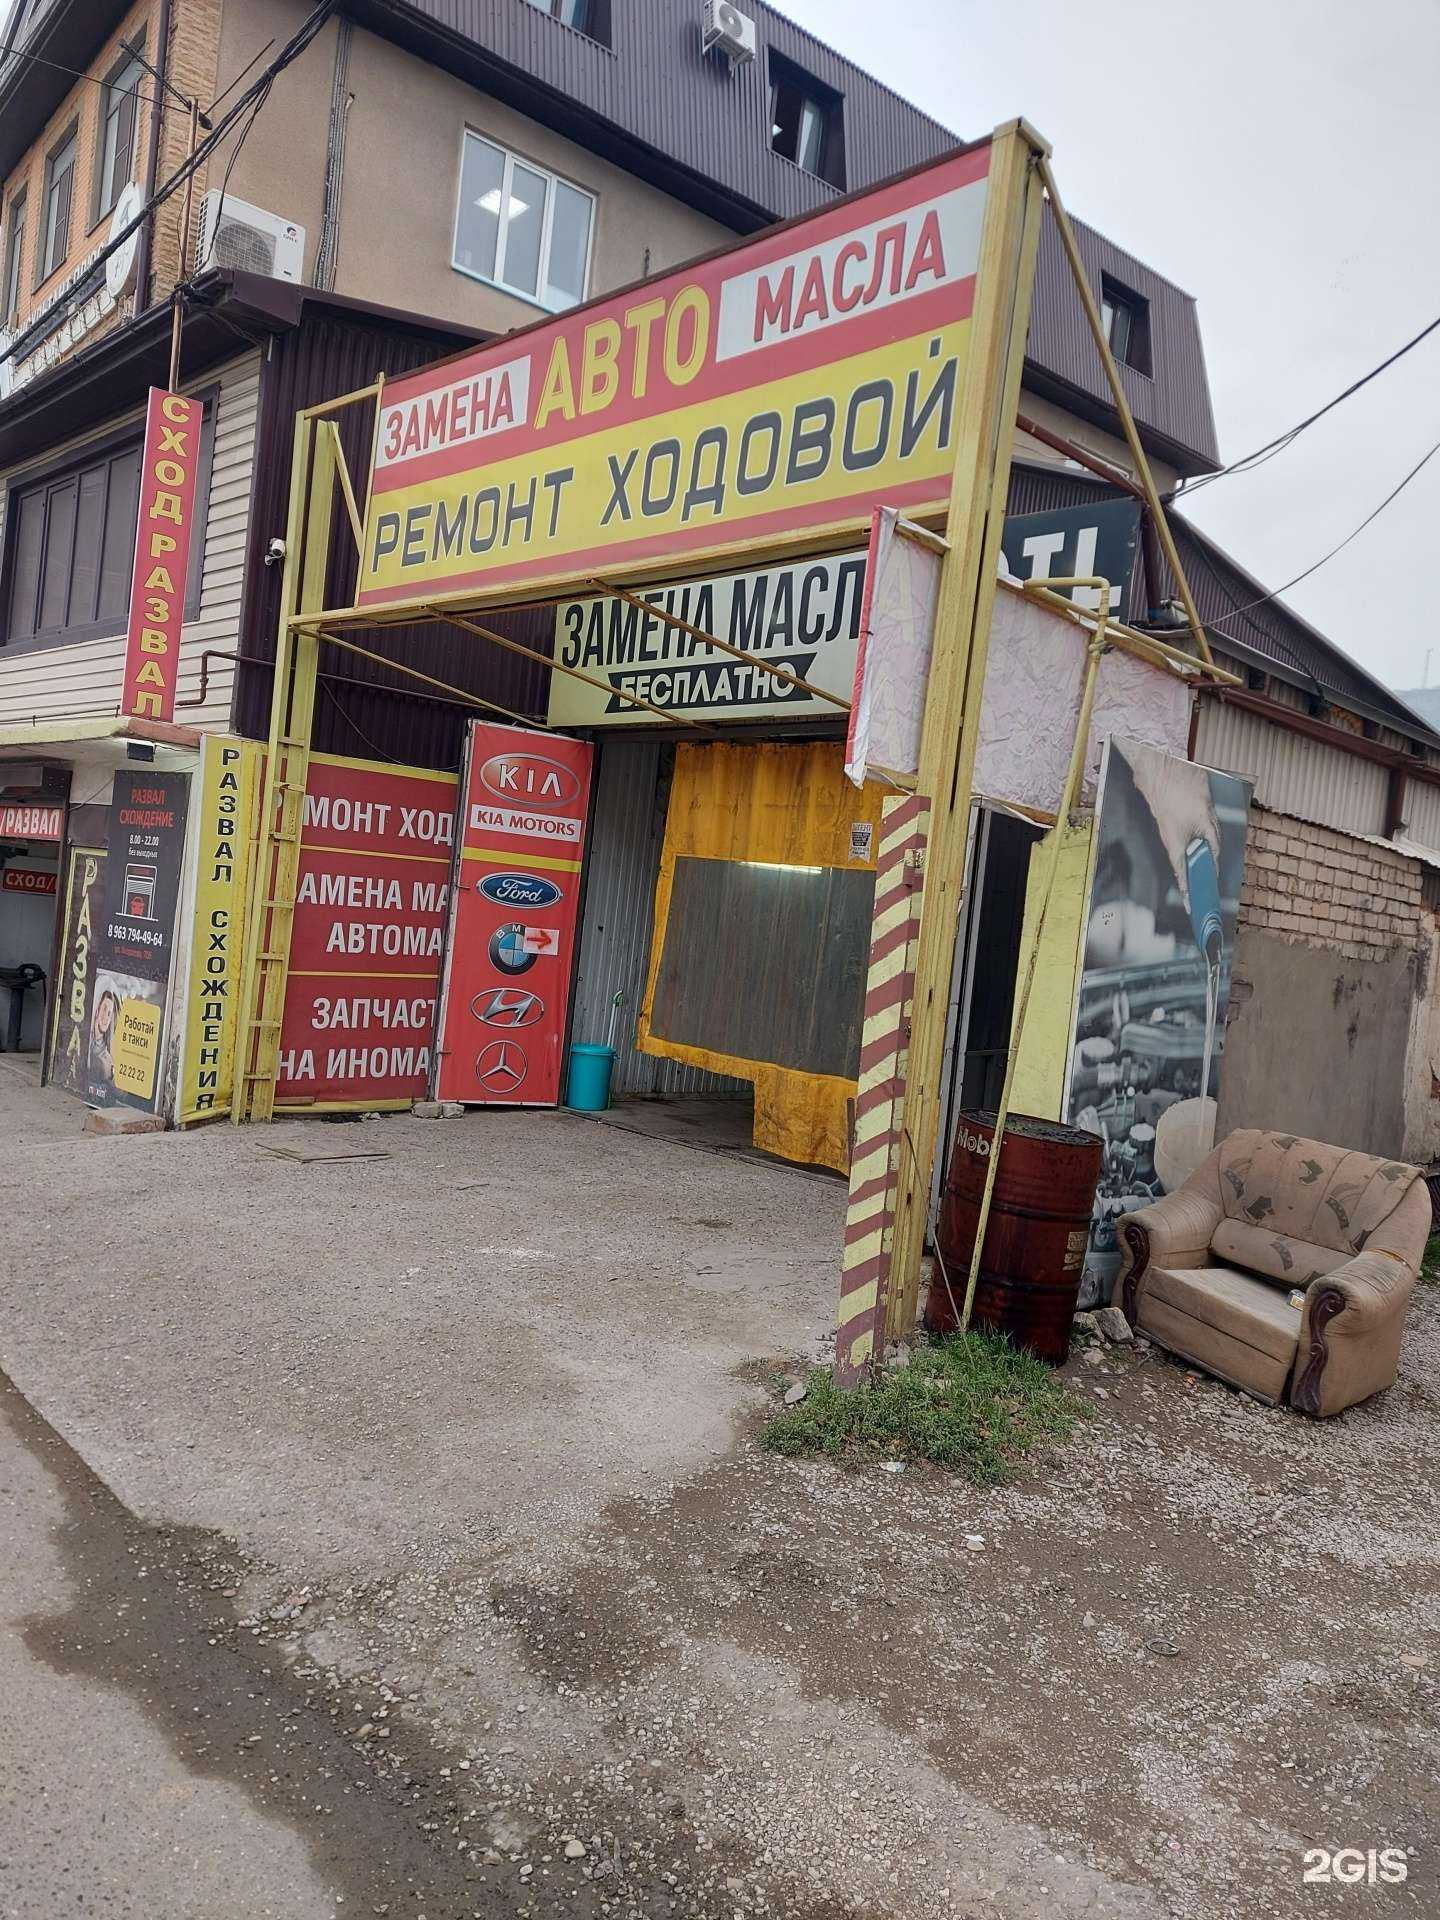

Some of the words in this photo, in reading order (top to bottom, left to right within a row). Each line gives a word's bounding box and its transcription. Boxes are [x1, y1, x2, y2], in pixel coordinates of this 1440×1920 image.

[384, 371, 514, 460] ЗАМЕНА
[533, 284, 711, 430] АВТО
[753, 210, 947, 342] МАСЛА
[149, 396, 191, 525] СХОД
[371, 467, 574, 573] РЕМОНТ
[600, 337, 960, 525] ХОДОВОЙ
[132, 532, 176, 718] РАЗВАЛ
[561, 584, 713, 668] ЗАМЕНА
[728, 559, 867, 650] МАСЛ
[619, 662, 798, 708] БЕСПЛАТНО
[131, 789, 165, 804] РАЗВАЛ
[500, 764, 561, 797] KIA
[120, 809, 175, 829] СХОЖДЕНИЕ
[212, 748, 240, 882] РАЗВАЛ
[303, 795, 391, 834] МОНТ
[399, 807, 454, 846] ХОД
[477, 810, 504, 826] KIA
[509, 815, 575, 836] MOTORS
[129, 834, 141, 845] 8.00
[144, 836, 159, 847] 22.00
[7, 872, 56, 890] СХОД/
[297, 873, 402, 910] АМЕНА
[412, 882, 450, 913] МА
[497, 878, 544, 902] Ford
[108, 924, 113, 937] 8
[113, 925, 126, 940] 963
[128, 928, 163, 947] 794-49-64
[326, 922, 443, 957] АВТОМА
[124, 1015, 154, 1035] Работай
[196, 910, 229, 1110] СХОЖДЕНИЯ
[312, 998, 438, 1029] ЗАПЧАСТ
[122, 1032, 127, 1041] в
[128, 1034, 148, 1048] такси
[119, 1064, 127, 1075] 22
[128, 1066, 136, 1078] 22
[137, 1069, 145, 1081] 22
[277, 1049, 316, 1080] НА
[326, 1047, 430, 1079] ИНОМА
